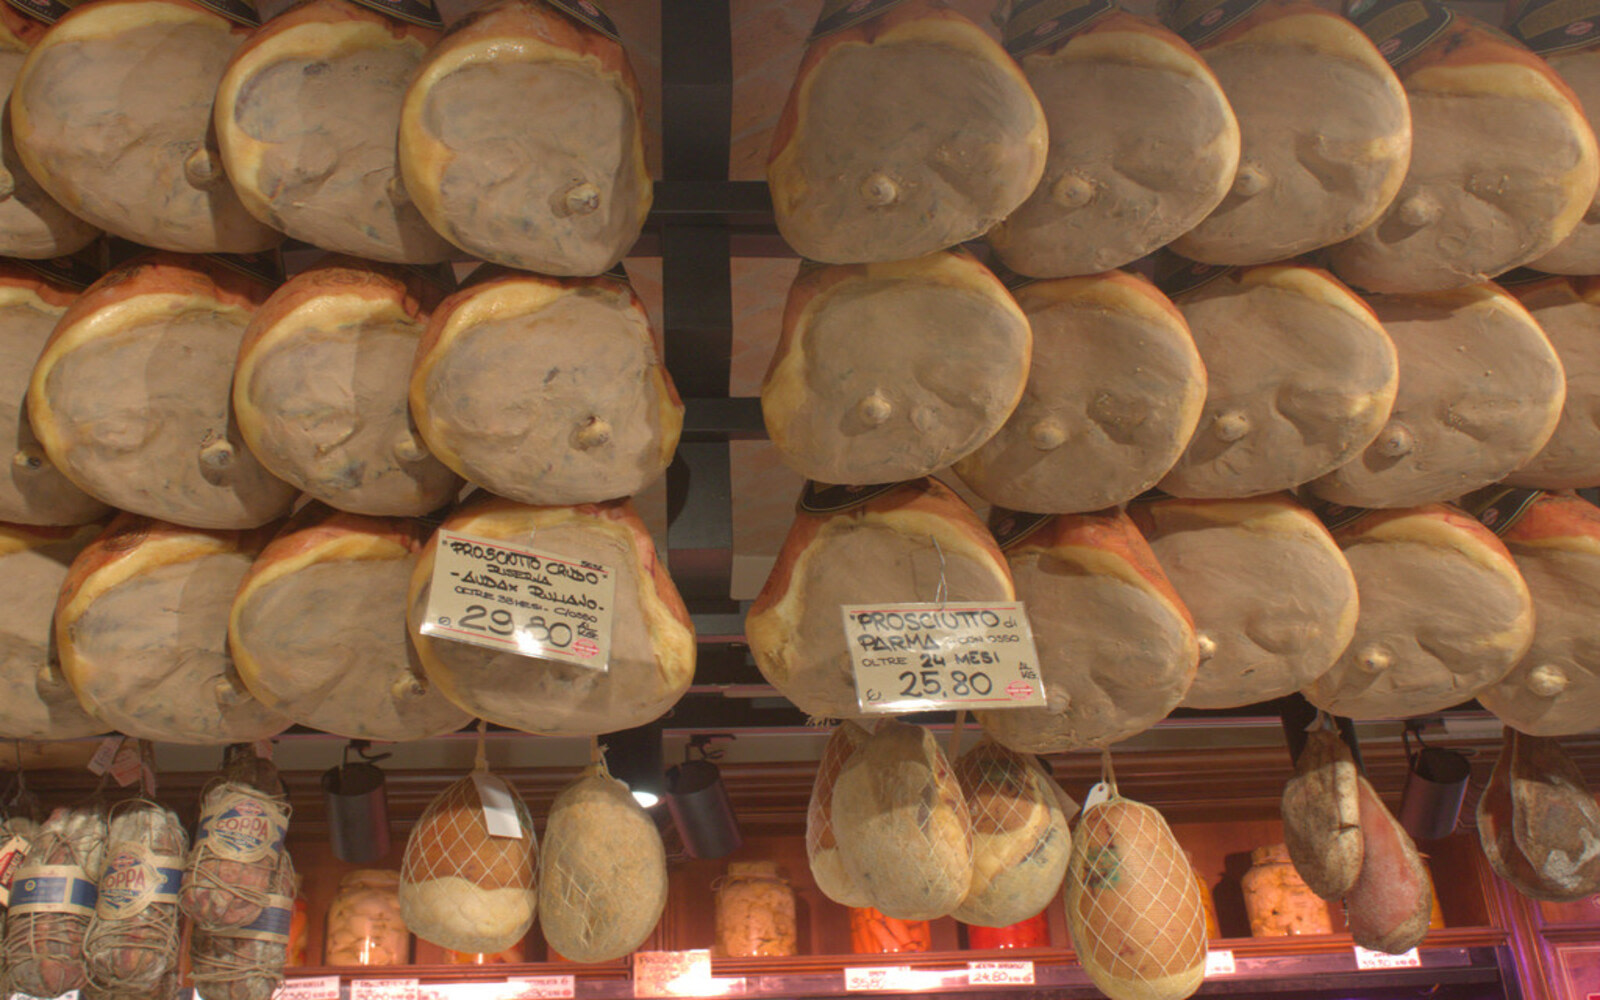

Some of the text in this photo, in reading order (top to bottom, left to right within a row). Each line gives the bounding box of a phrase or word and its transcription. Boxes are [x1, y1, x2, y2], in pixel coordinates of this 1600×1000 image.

[458, 605, 572, 648] 2980
[1003, 616, 1018, 628] di
[857, 633, 941, 652] PARMA
[987, 634, 1020, 643] OSSO
[862, 650, 1000, 669] OLTRE 24 MESI
[215, 817, 269, 841] COPPA
[102, 866, 146, 890] OPPA
